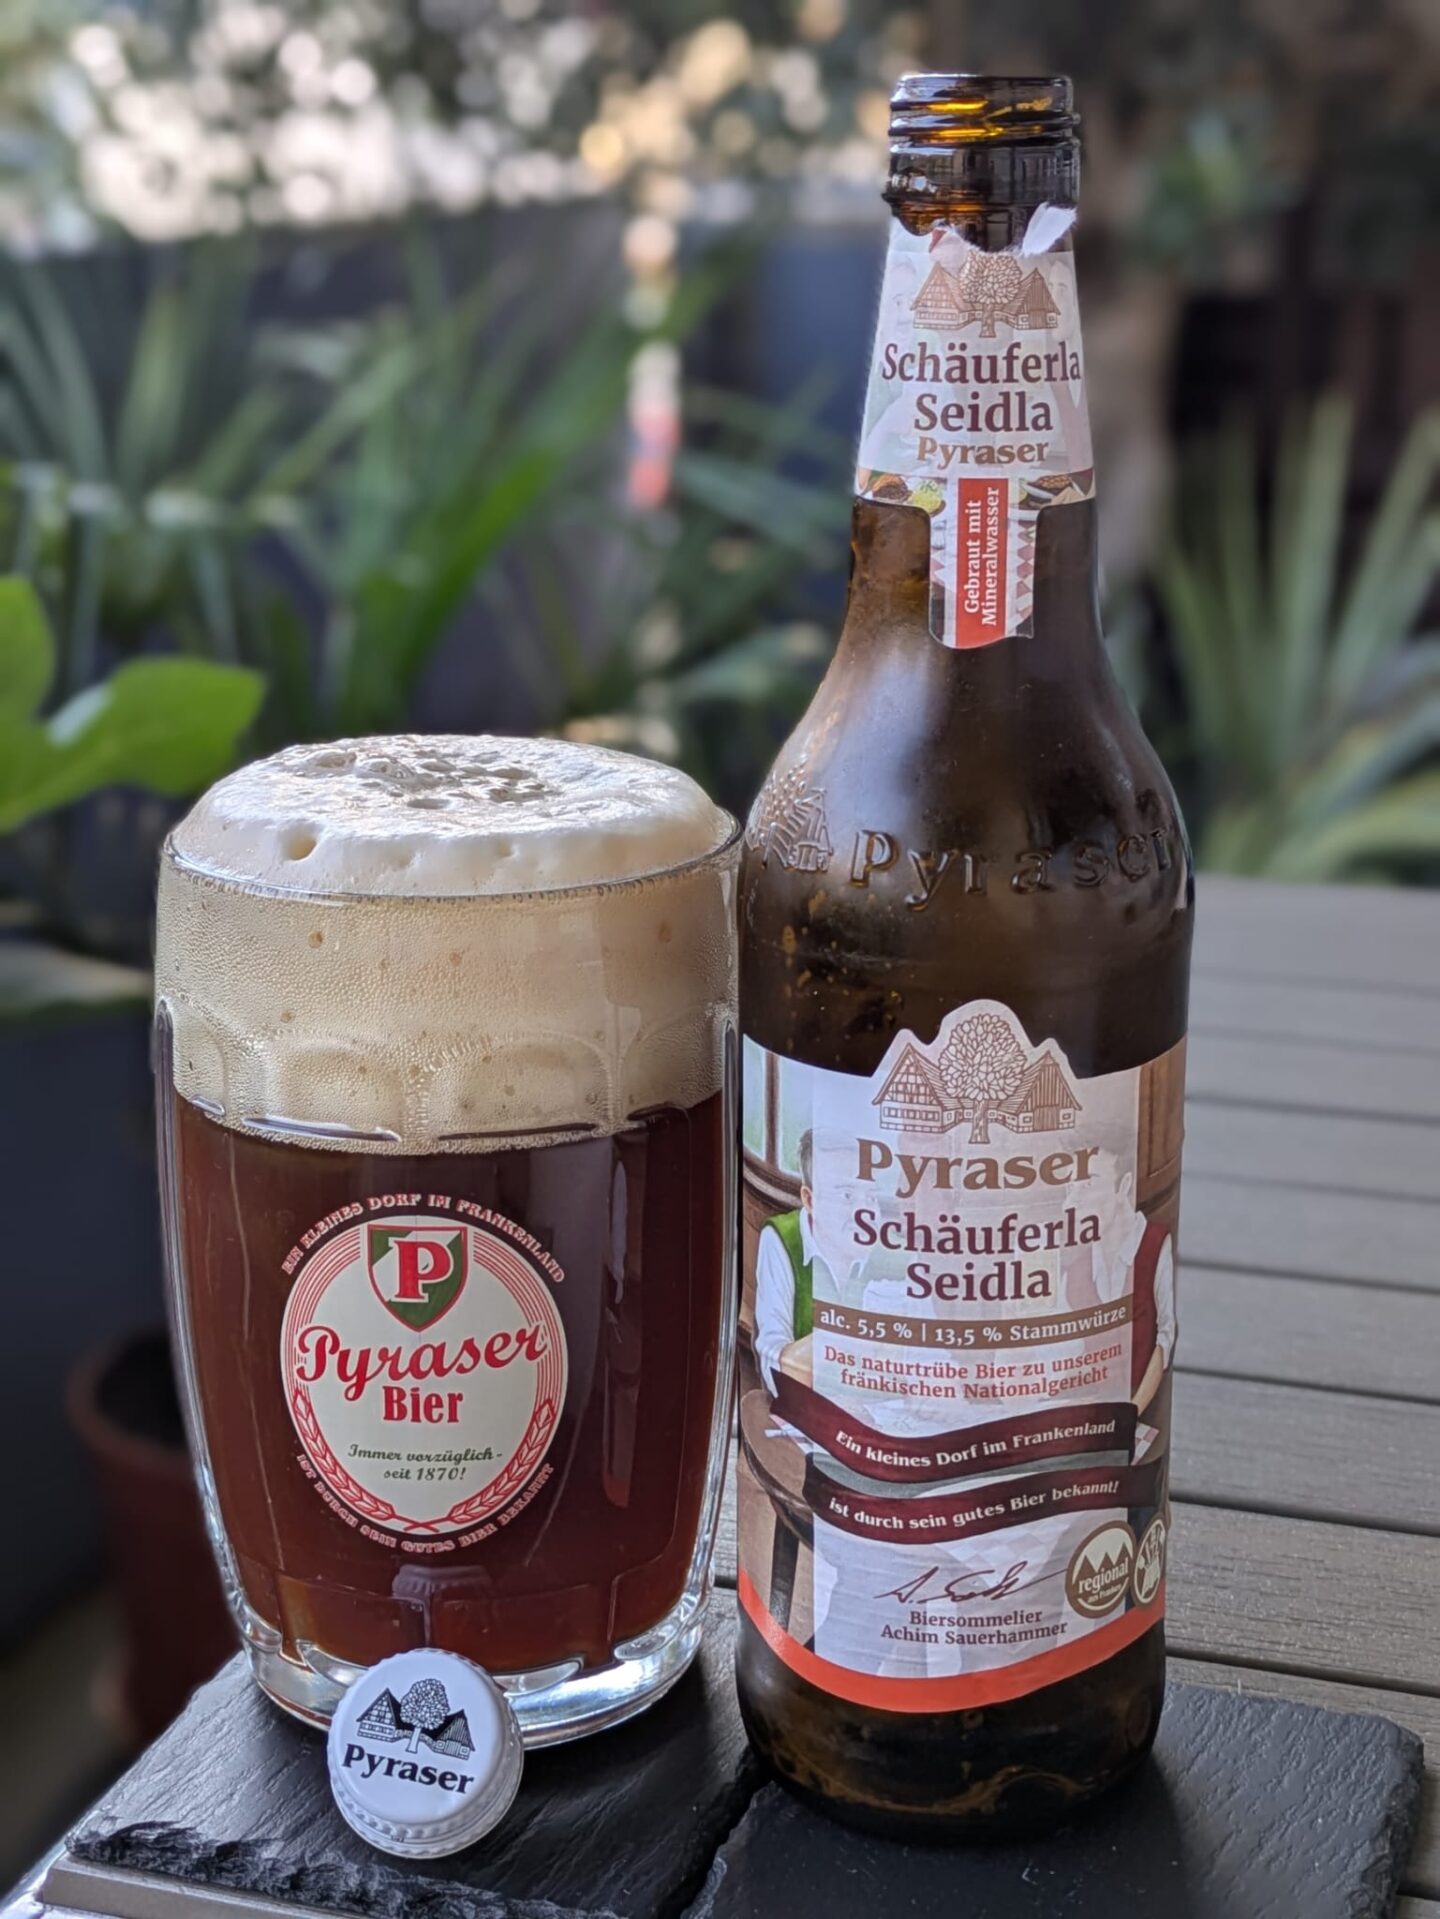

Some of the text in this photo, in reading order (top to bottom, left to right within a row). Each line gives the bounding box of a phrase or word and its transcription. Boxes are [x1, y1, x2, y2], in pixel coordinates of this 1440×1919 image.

[882, 341, 1082, 384] Schäuferla
[914, 391, 1053, 433] Seidla
[917, 436, 1049, 469] Pyraser
[963, 499, 982, 614] Gebraut mit
[982, 487, 999, 626] Mineralwasser
[856, 1138, 1099, 1199] Pyraser
[281, 1193, 566, 1284] EIN KLEINES DORF IM FRANKENLAND
[853, 1207, 1102, 1254] Schäuferla
[394, 1240, 451, 1300] P
[906, 1262, 1052, 1301] Seidla
[820, 1310, 851, 1330] alc.
[857, 1318, 887, 1341] 5,5
[892, 1323, 913, 1340] %
[935, 1328, 975, 1346] 13,5
[982, 1326, 1003, 1343] %
[1010, 1305, 1127, 1342] Stammwürze
[296, 1325, 548, 1401] Pyraser
[824, 1343, 1123, 1380] Das naturtrübe Bier zu unserem
[382, 1386, 464, 1423] Bier
[840, 1367, 1109, 1400] fränkischen Nationalgericht
[347, 1444, 403, 1462] Immer
[406, 1449, 492, 1466] vorzüglich
[835, 1420, 1117, 1468] Ein kleines Dorf im Frankenland
[383, 1467, 468, 1482] seit 1870!
[297, 1454, 317, 1479] IST
[314, 1481, 359, 1528] DURCH
[400, 1539, 456, 1554] GUTES
[458, 1522, 499, 1548] BIER
[497, 1462, 555, 1527] BEKANNT
[828, 1479, 1120, 1530] ist durch sein gutes Bier bekannt!
[1078, 1557, 1129, 1596] regional
[880, 1621, 1069, 1645] Achim Sauerhammer
[910, 1609, 1043, 1628] Biersommelier
[341, 1743, 475, 1794] Pyraser
